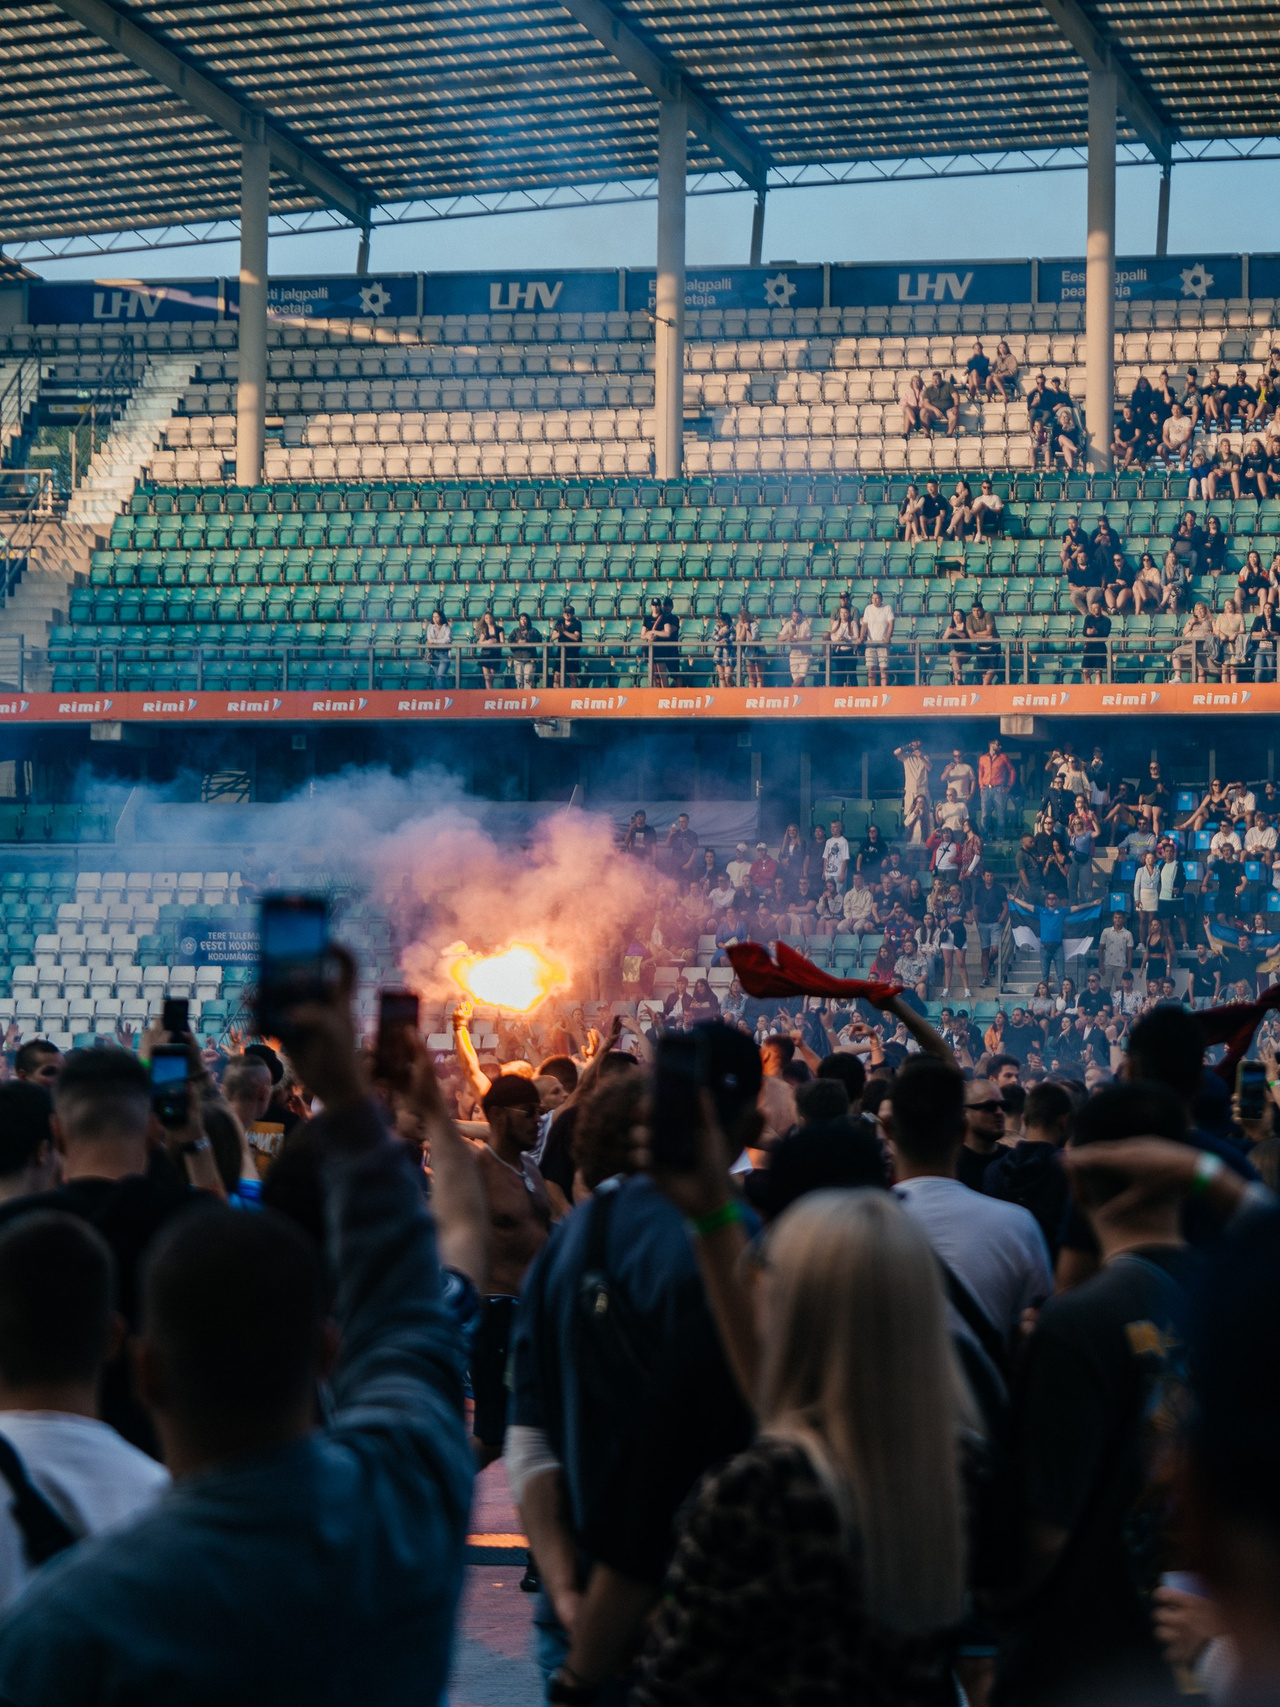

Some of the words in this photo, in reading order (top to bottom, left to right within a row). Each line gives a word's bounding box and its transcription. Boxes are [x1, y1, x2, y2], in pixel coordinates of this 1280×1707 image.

[898, 272, 974, 301] LHV
[281, 287, 329, 302] jalgpalli
[489, 281, 563, 310] LHV
[93, 290, 163, 318] LHV
[268, 303, 313, 316] toetaja
[0, 701, 17, 714] mi
[208, 931, 228, 940] TERE
[200, 941, 226, 950] EESTI
[229, 941, 260, 951] KOOND
